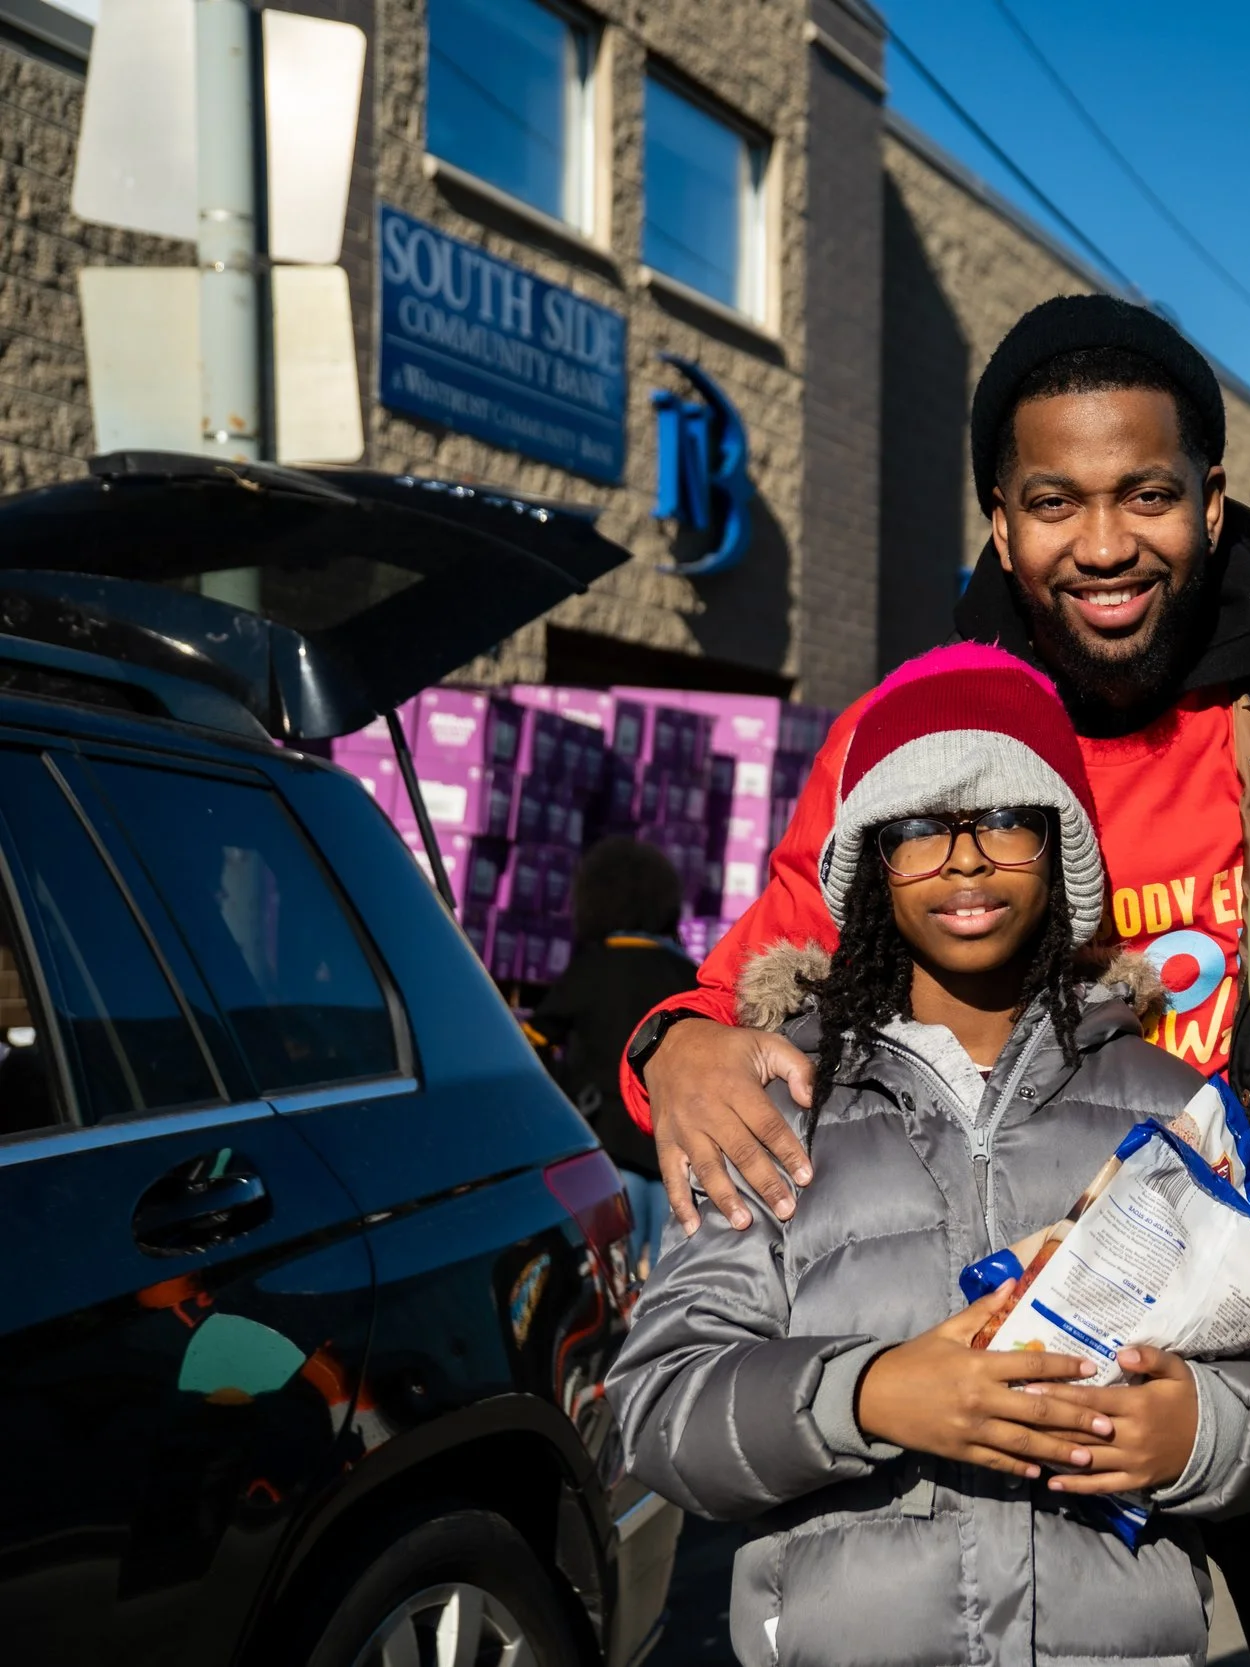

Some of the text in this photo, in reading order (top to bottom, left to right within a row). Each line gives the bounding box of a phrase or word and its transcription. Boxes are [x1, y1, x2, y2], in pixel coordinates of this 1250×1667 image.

[384, 215, 624, 376] SOUTH SIDE
[399, 297, 611, 409] COMMUNITY BANK
[1098, 876, 1196, 940] ODY
